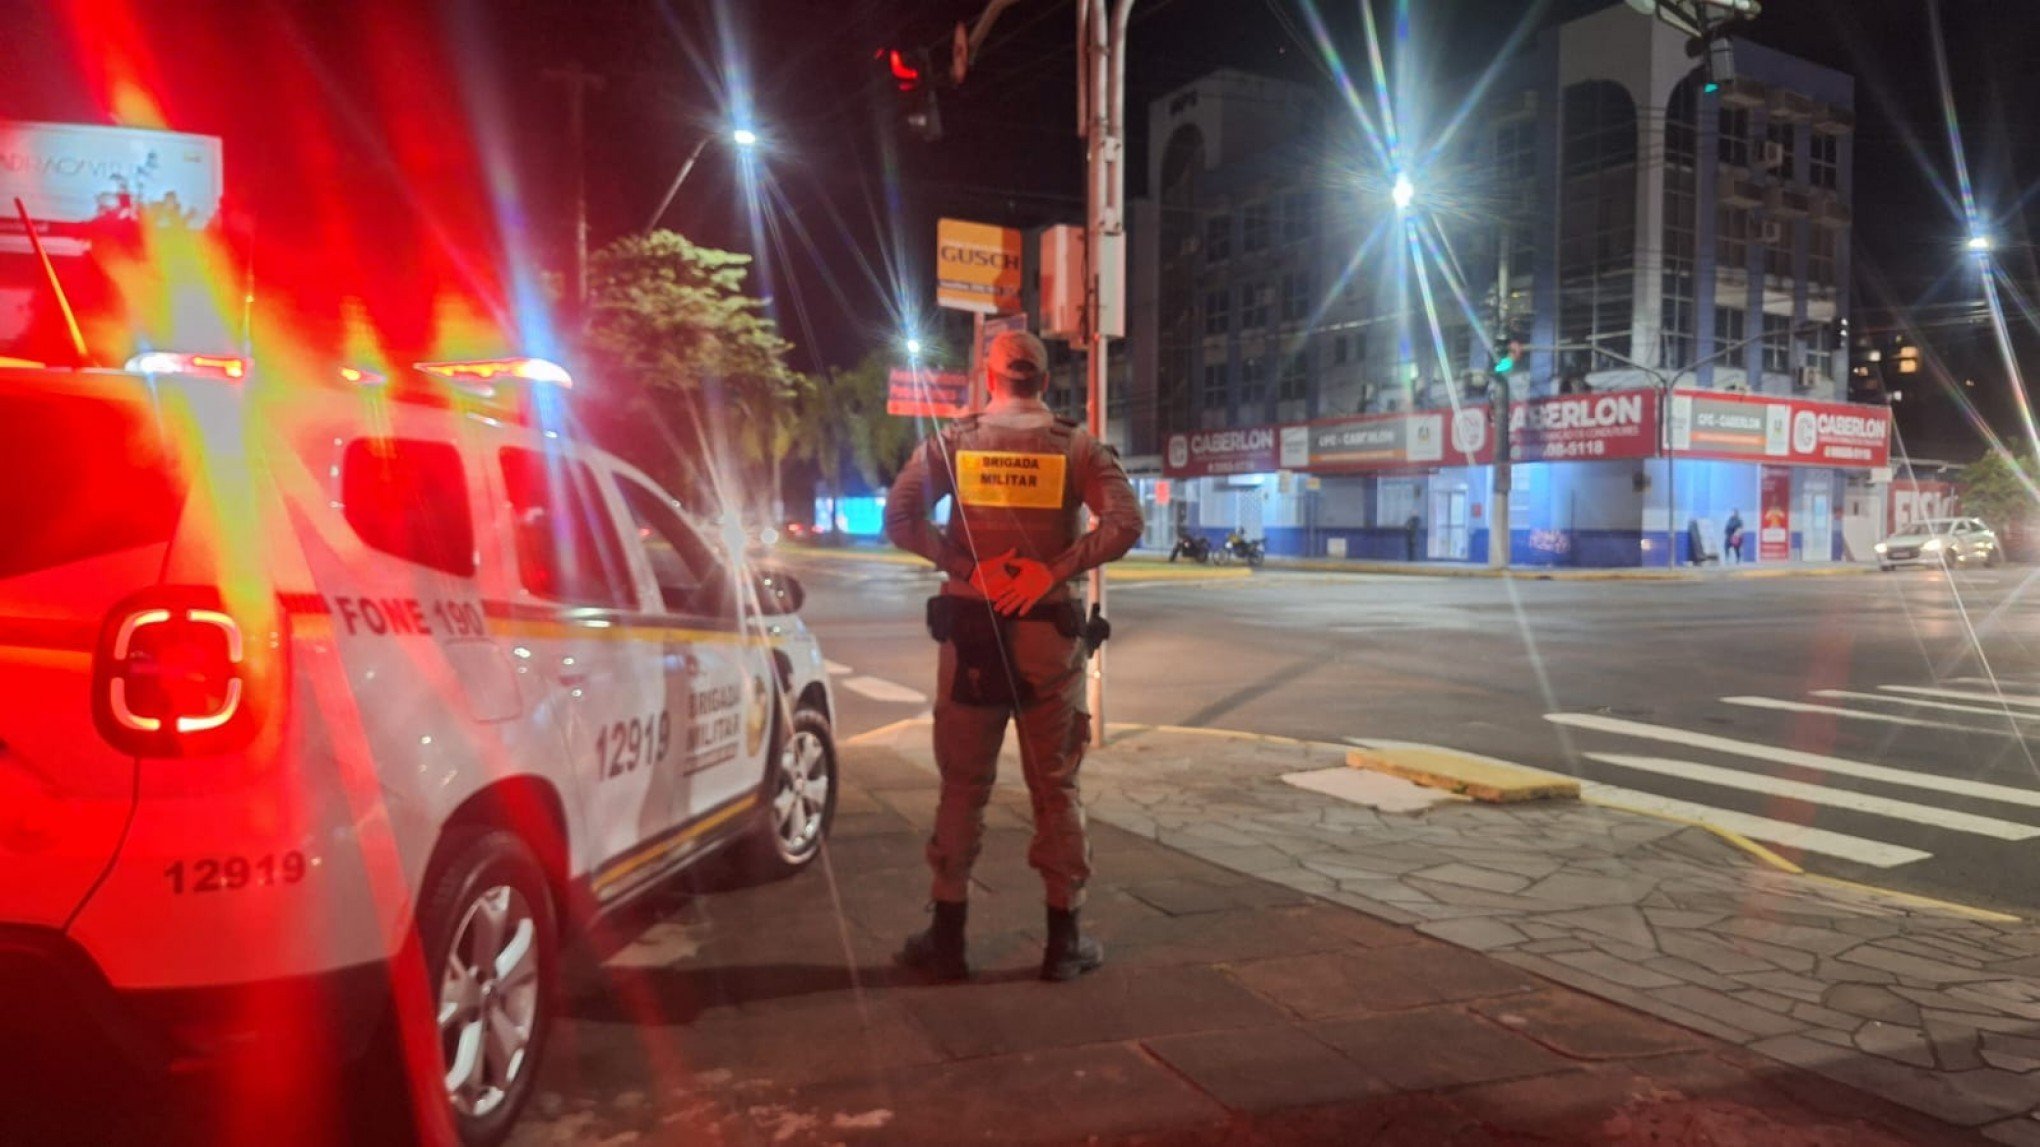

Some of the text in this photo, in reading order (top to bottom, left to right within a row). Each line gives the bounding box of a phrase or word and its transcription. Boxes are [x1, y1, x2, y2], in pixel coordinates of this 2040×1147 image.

[941, 245, 1019, 270] GUSCH
[1817, 413, 1886, 438] CABERLON
[1191, 427, 1274, 455] CABERLON
[982, 457, 1039, 470] BRIGADA
[980, 474, 1037, 487] MILITAR
[334, 596, 484, 636] FONE 190
[596, 709, 671, 782] 12919
[685, 713, 741, 752] MILITAR
[164, 850, 306, 895] 12919
